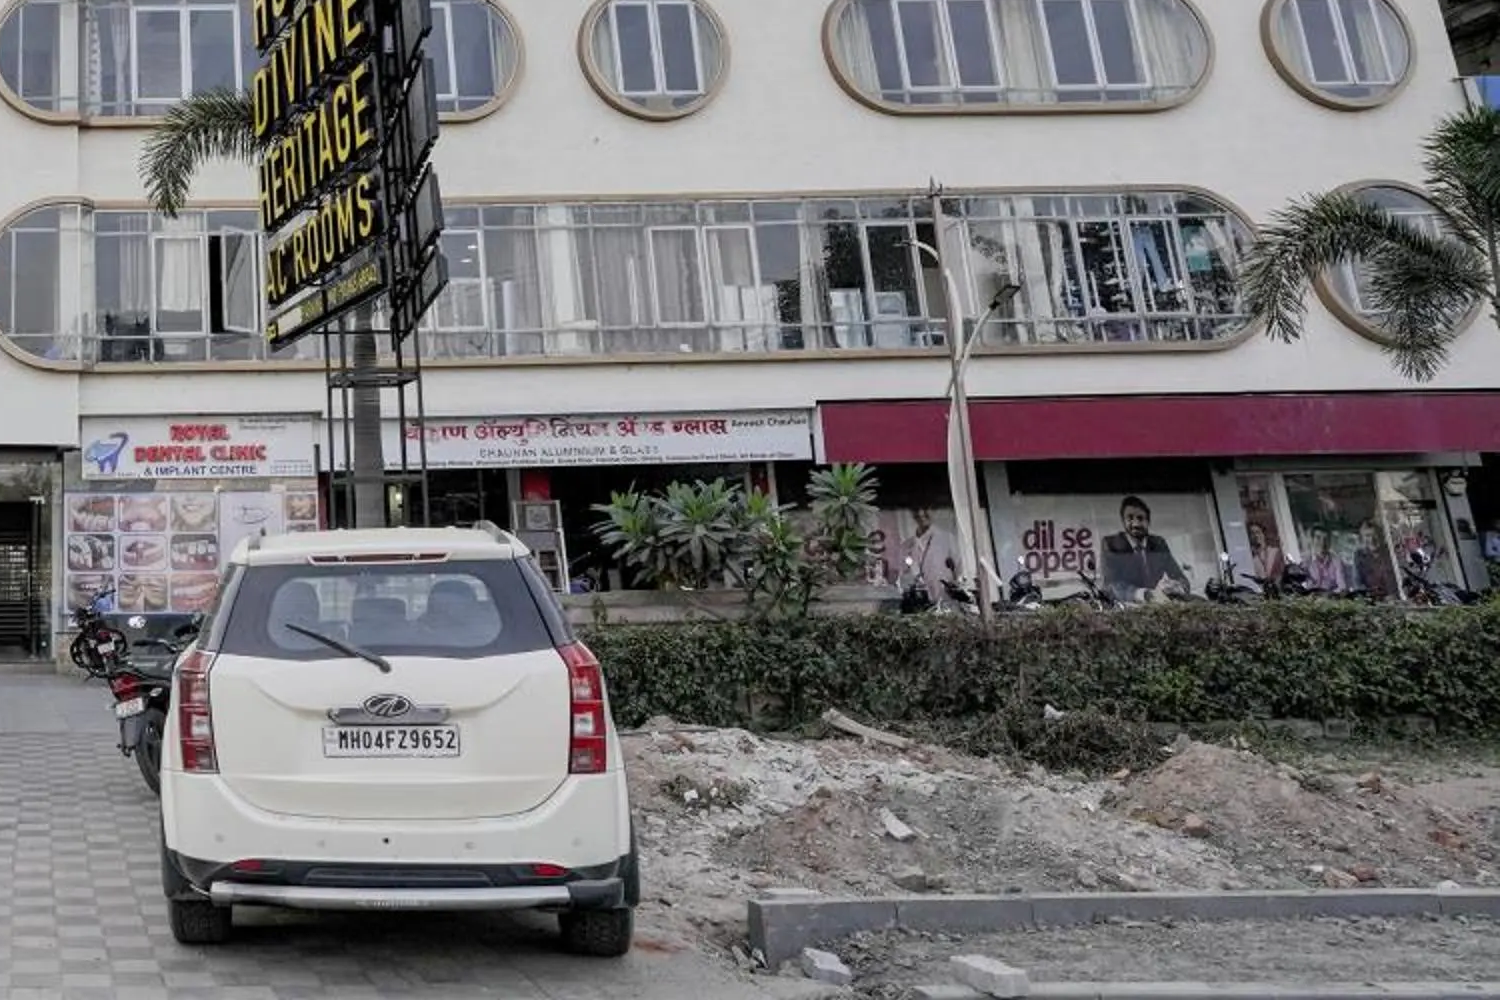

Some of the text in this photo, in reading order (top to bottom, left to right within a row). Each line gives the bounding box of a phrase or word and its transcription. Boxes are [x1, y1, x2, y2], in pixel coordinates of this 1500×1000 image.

[259, 65, 369, 229] HERITAGE
[293, 174, 376, 285] ROOMS
[170, 424, 231, 441] ROYAL
[134, 445, 267, 463] DENTAL CLINIC
[155, 466, 206, 476] IMPLANT
[210, 465, 257, 475] CENTRE
[1023, 519, 1093, 550] dil se
[339, 730, 456, 749] MH04FZ9652
